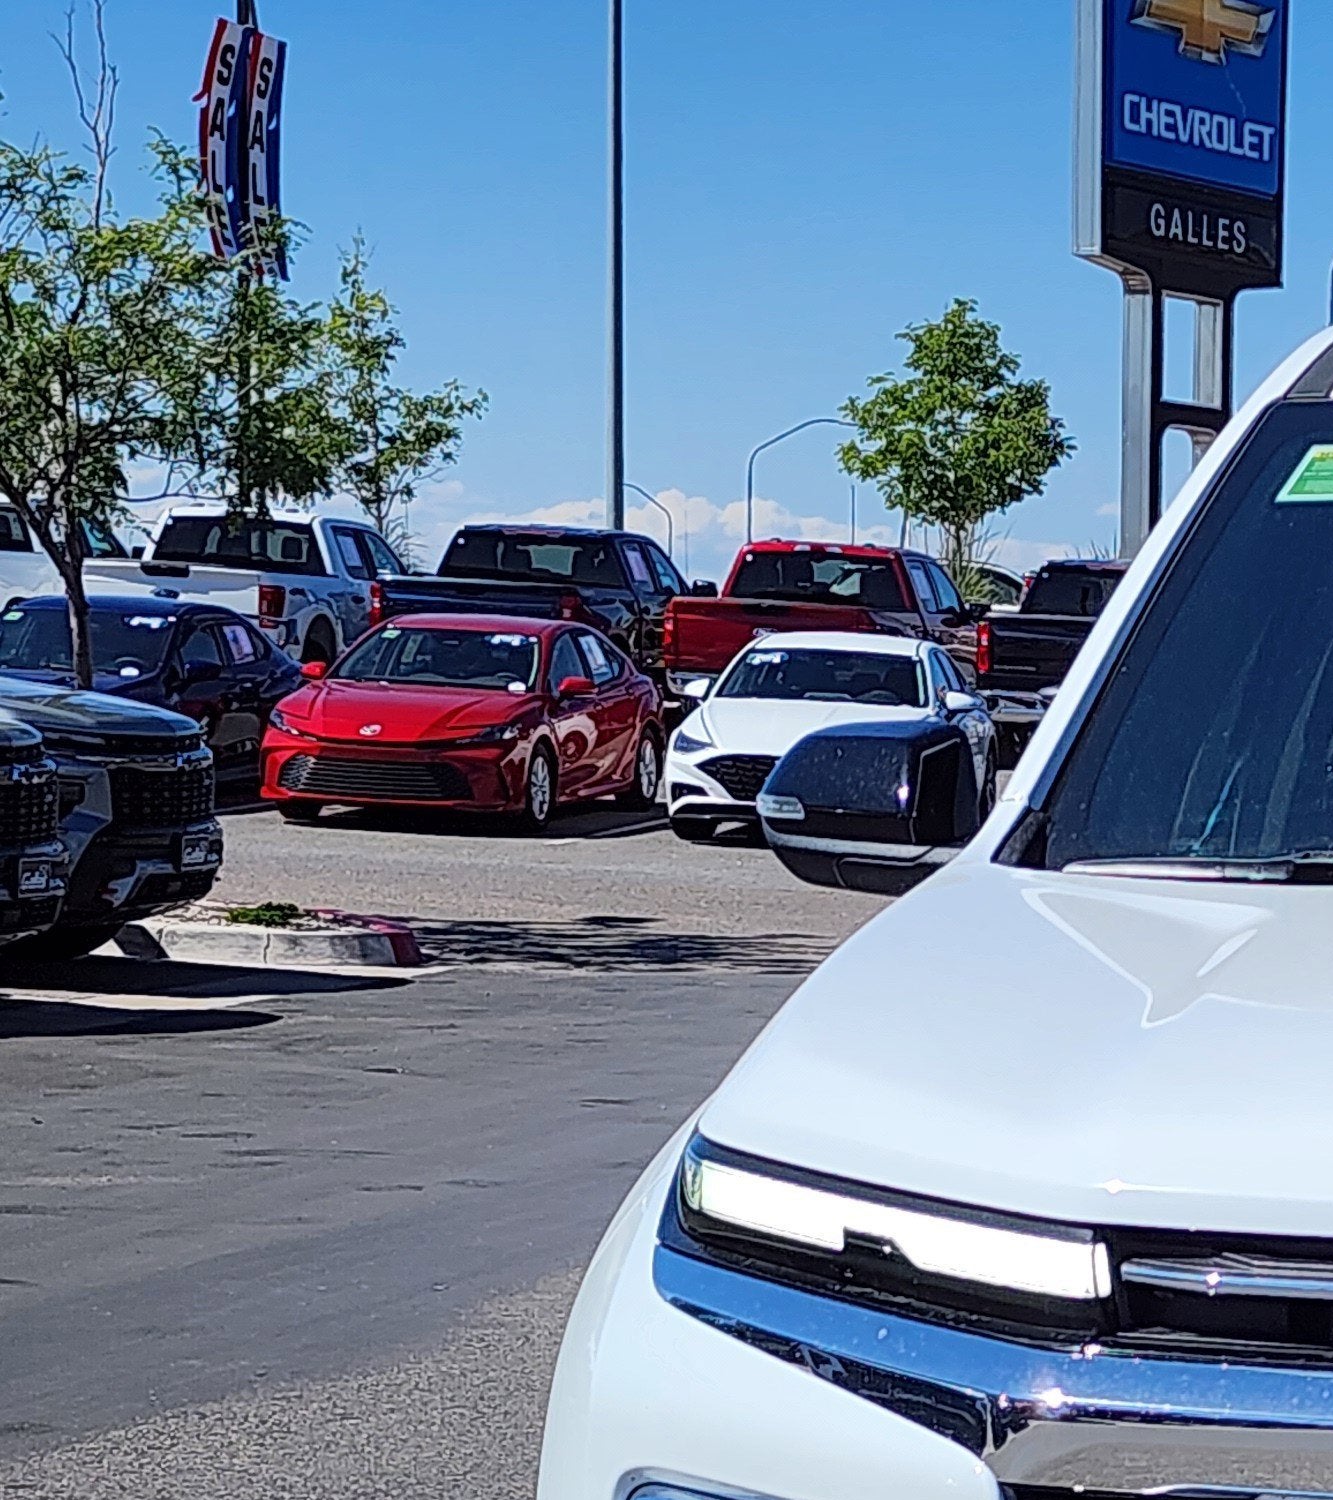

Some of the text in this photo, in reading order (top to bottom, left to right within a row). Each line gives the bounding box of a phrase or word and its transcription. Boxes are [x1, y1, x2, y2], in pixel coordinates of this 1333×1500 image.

[207, 43, 236, 248] SALE
[1123, 93, 1276, 162] CHEVROLET
[1150, 202, 1247, 254] GALLES
